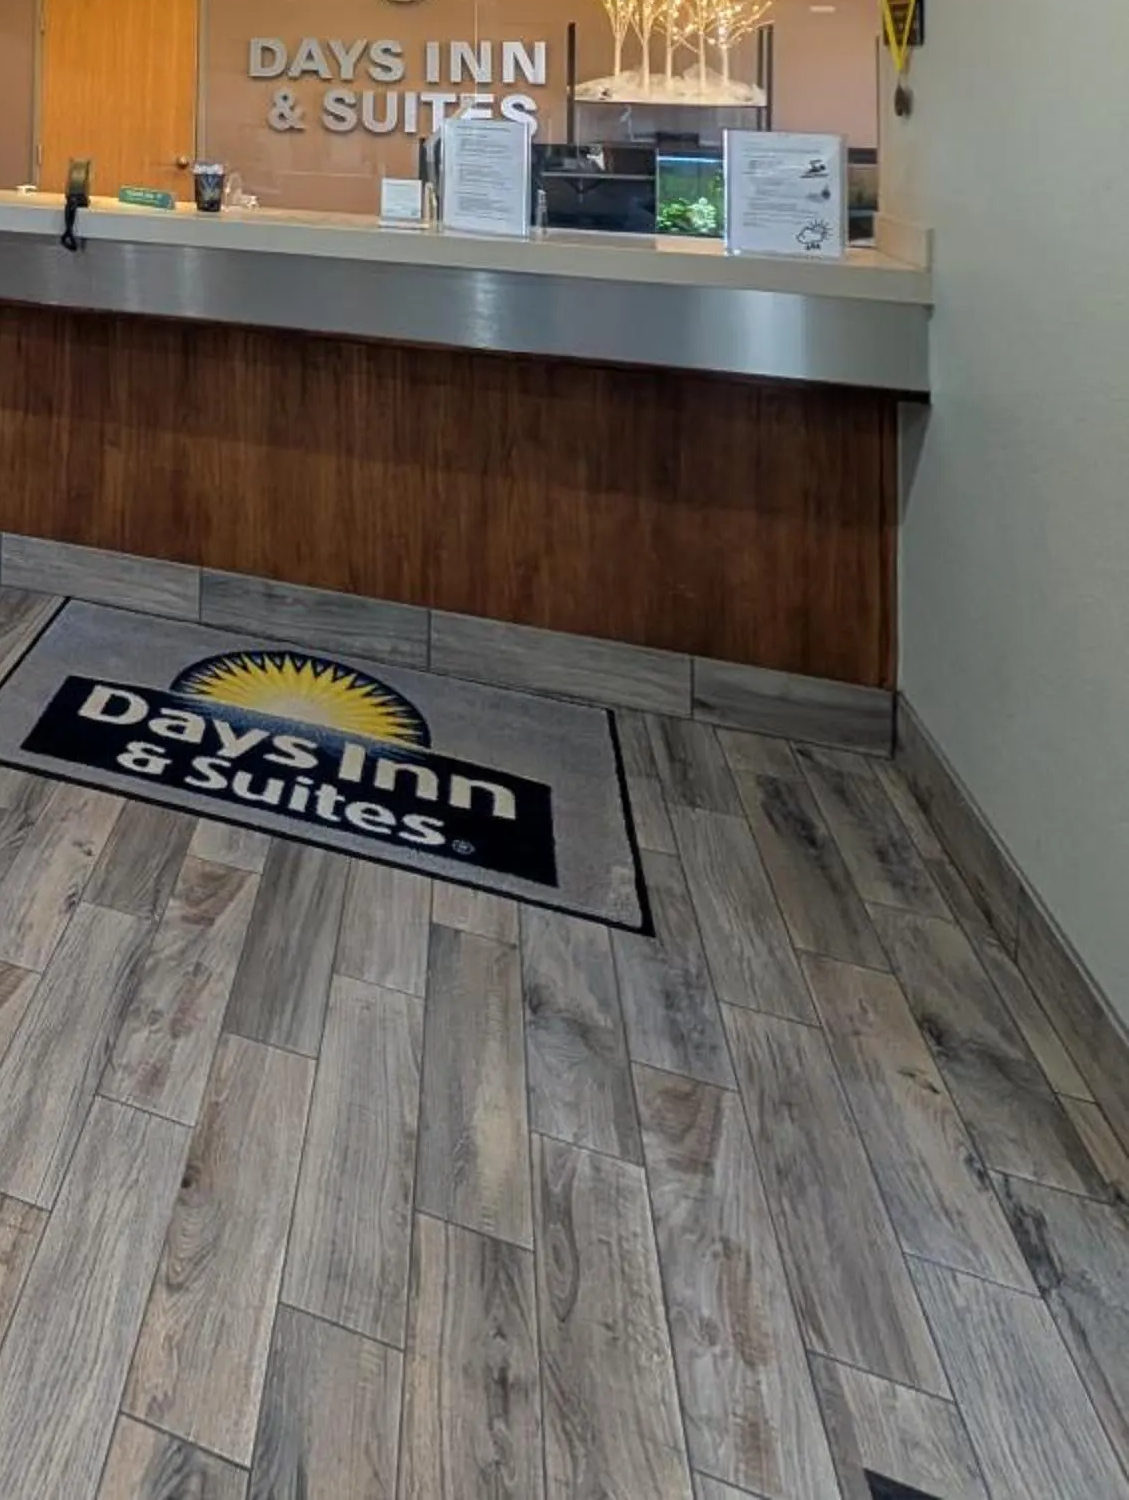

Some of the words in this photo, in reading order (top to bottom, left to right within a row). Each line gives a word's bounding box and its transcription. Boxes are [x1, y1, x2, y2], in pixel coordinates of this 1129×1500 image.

[249, 37, 405, 82] DAYS
[426, 40, 546, 85] INN
[268, 87, 305, 132] &
[323, 88, 538, 137] SUITES
[78, 684, 319, 770] Days
[338, 740, 517, 821] Inn
[116, 740, 171, 775] &
[184, 756, 446, 846] Suites
